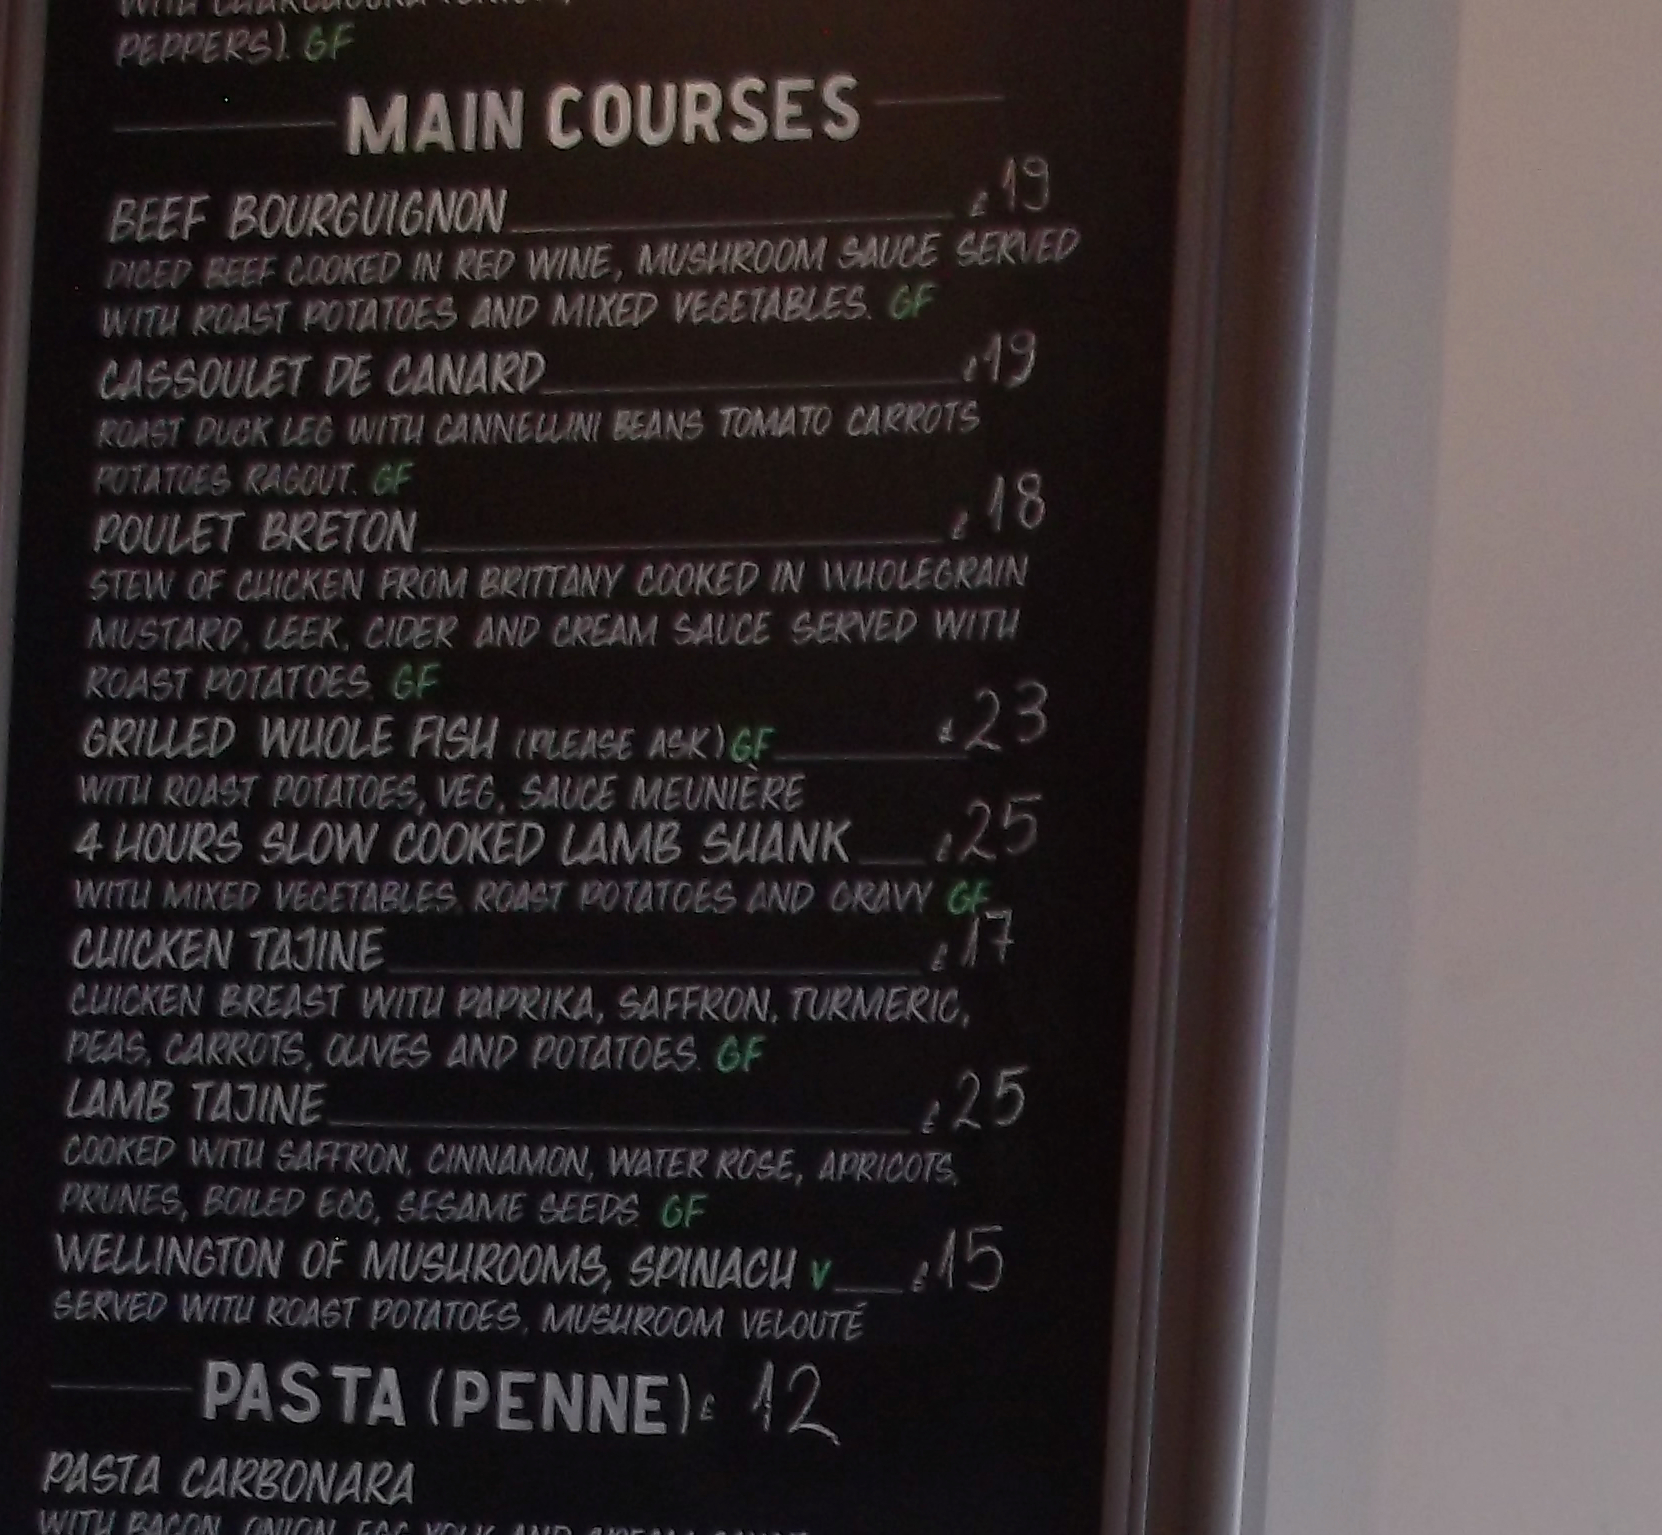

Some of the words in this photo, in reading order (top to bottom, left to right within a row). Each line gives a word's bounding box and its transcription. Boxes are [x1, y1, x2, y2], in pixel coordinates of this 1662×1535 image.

[304, 22, 354, 61] GF
[347, 89, 523, 154] MAIN
[547, 75, 859, 148] COURSES
[110, 194, 210, 242] BEEF
[229, 188, 507, 240] BOURGUIGNON
[287, 251, 401, 286] COOKED
[413, 252, 442, 281] IN
[455, 248, 515, 280] RED
[638, 237, 827, 275] MUSHROOM
[838, 232, 941, 268] SAUCE
[957, 228, 1079, 266] SERVED
[193, 300, 291, 336] ROAST
[303, 295, 457, 332] POTATOES
[471, 295, 538, 329] AND
[552, 292, 658, 327] MIXED
[99, 355, 312, 400] CASSOULET
[325, 354, 372, 397] DE
[388, 350, 545, 395] CANARD
[281, 415, 332, 446] LEG
[349, 413, 424, 445] WITH
[435, 412, 601, 445] CANNELLINI
[613, 409, 703, 440] BEANS
[720, 405, 831, 437] TOMATO
[847, 401, 979, 436] CARROTS
[372, 461, 413, 496] GF
[94, 511, 245, 555] POULET
[260, 509, 416, 553] BRETON
[90, 568, 174, 600] STEW
[188, 569, 226, 600] OF
[236, 568, 364, 601] CHICKEN
[380, 566, 467, 600] FROM
[479, 564, 624, 598] BRITTANY
[637, 561, 759, 596] COOKED
[771, 561, 804, 592] IN
[823, 556, 1028, 590] WHOLEGRAIN
[366, 615, 458, 649] CIDER
[475, 615, 540, 648] AND
[553, 613, 658, 647] CREAM
[675, 611, 771, 645] SAUCE
[792, 608, 917, 644] SERVED
[935, 609, 1019, 640] WITH
[86, 666, 191, 701] ROAST
[392, 663, 440, 699] GF
[83, 716, 235, 758] GRILLED
[262, 715, 393, 759] WHOLE
[411, 715, 499, 760] FISH
[515, 728, 634, 760] (PLEASE
[649, 724, 724, 758] ASK)
[730, 727, 774, 762] GF
[79, 775, 152, 804] WITH
[164, 774, 258, 807] ROAST
[521, 774, 617, 811] SAUCE
[75, 822, 103, 861] 4
[115, 821, 242, 863] HOURS
[261, 821, 379, 864] SLOW
[393, 821, 545, 866] COOKED
[561, 821, 681, 866] LAMB
[701, 820, 851, 864] SHANK
[580, 879, 736, 913] POTATOES
[747, 880, 814, 913] AND
[830, 881, 932, 913] GRAVY
[948, 881, 988, 914] GF
[72, 927, 233, 970] CHICKEN
[250, 927, 384, 971] TAJINE
[70, 983, 203, 1016] CHICKEN
[220, 983, 344, 1019] BREAST
[363, 985, 444, 1019] WITH
[325, 1033, 431, 1068] OLIVES
[447, 1034, 517, 1070] AND
[717, 1035, 765, 1073] GF
[66, 1079, 173, 1122] LAMB
[192, 1081, 326, 1125] TAJINE
[64, 1134, 175, 1166] COOKED
[191, 1138, 264, 1168] WITH
[610, 1147, 708, 1178] WATER
[203, 1185, 305, 1217] BOILED
[397, 1190, 526, 1222] SESAME
[662, 1194, 706, 1228] GF
[56, 1234, 283, 1278] WELLINGTON
[302, 1240, 347, 1278] OF
[630, 1246, 797, 1289] SPINACH
[54, 1290, 167, 1322] SERVED
[181, 1294, 255, 1323] WITH
[266, 1296, 360, 1328] ROAST
[542, 1303, 724, 1337] MUSHROOM
[204, 1360, 405, 1426] PASTA
[430, 1369, 689, 1434] (PENNE)
[43, 1452, 160, 1495] PASTA
[182, 1457, 413, 1505] CARBONARA
